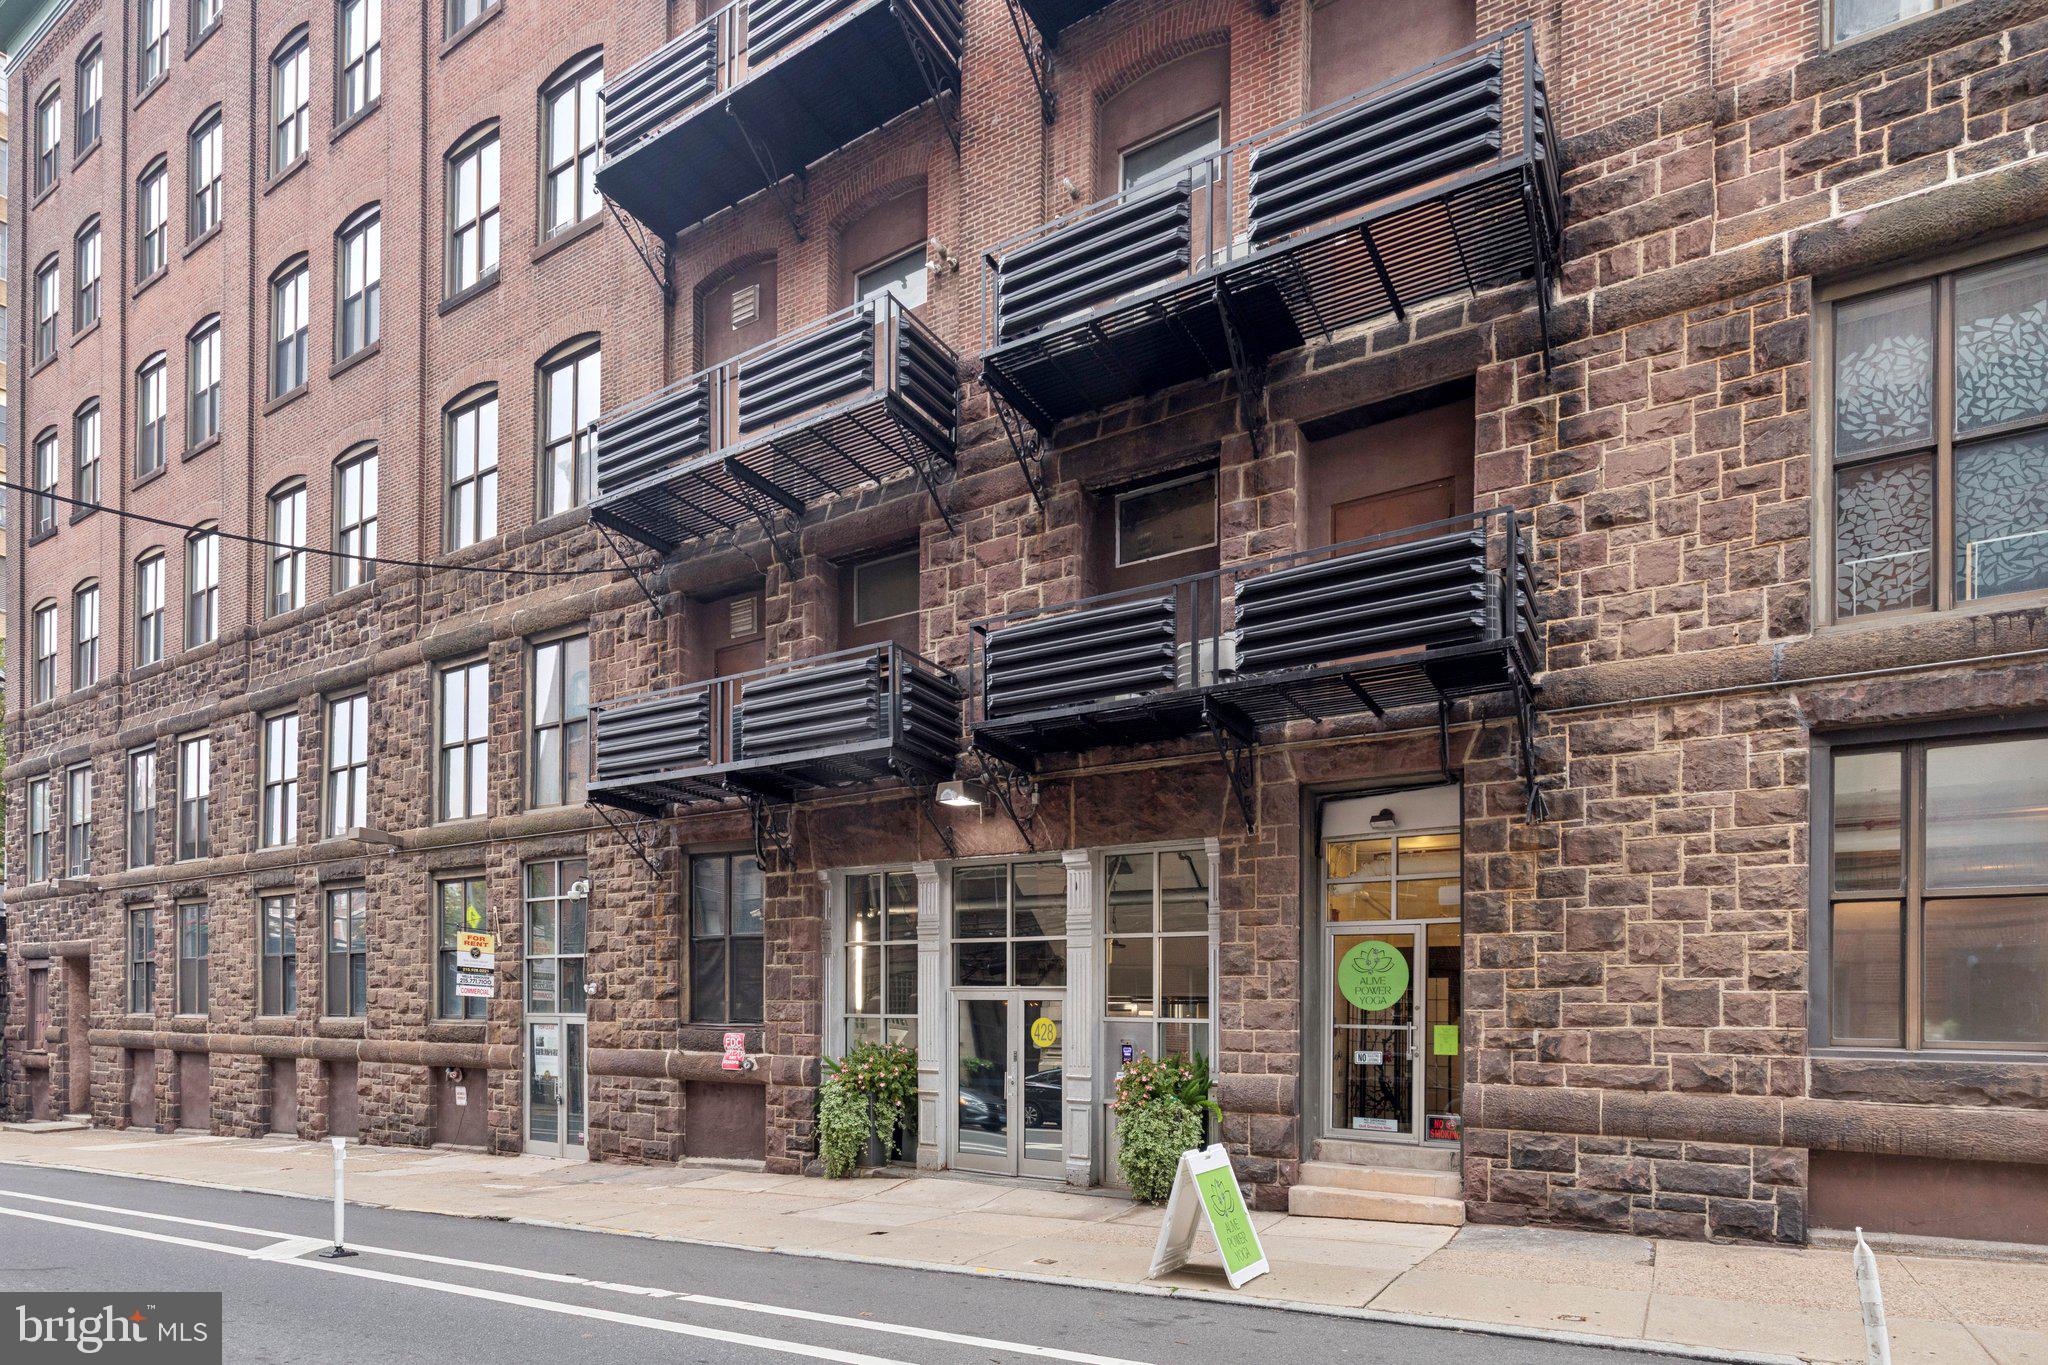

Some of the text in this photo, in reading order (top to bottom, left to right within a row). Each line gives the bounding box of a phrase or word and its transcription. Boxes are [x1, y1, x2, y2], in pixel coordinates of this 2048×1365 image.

[1360, 976, 1387, 985] ALIVE
[460, 987, 490, 996] COMMERCIAL
[1354, 986, 1392, 995] POWER
[1359, 996, 1387, 1005] YOGA
[1034, 1023, 1054, 1041] 428
[725, 1038, 742, 1047] FDC
[1357, 1053, 1367, 1062] NO
[1434, 1119, 1444, 1129] NO
[1430, 1128, 1461, 1140] SMOKING
[1225, 1217, 1241, 1234] ALIVE
[1226, 1231, 1249, 1249] POWER
[1233, 1246, 1252, 1263] YOGA
